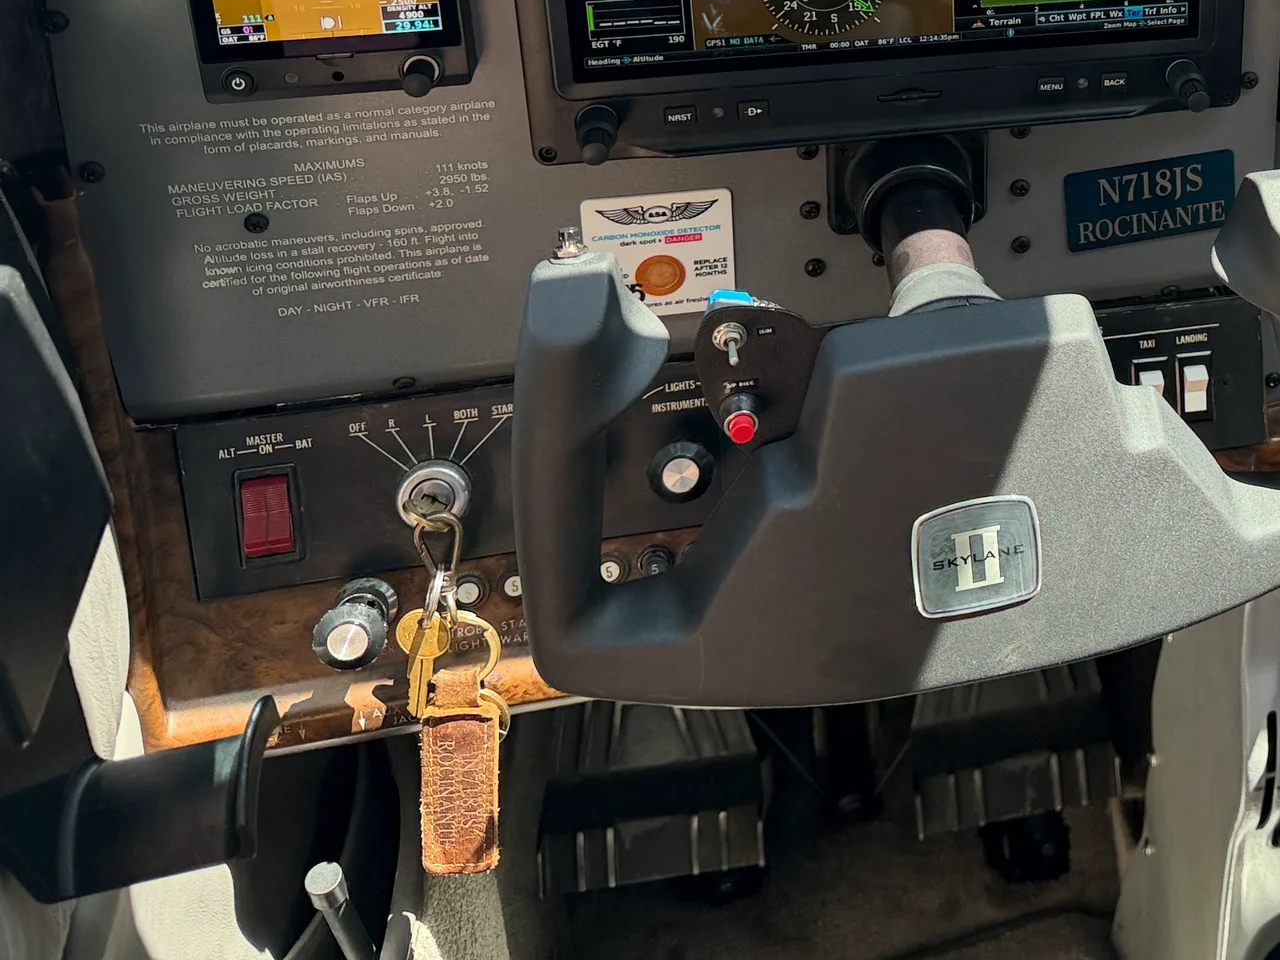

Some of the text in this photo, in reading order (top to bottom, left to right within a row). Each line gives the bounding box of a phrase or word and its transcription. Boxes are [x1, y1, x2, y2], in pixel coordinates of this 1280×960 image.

[989, 16, 1021, 26] Terrain
[588, 54, 664, 66] Heading Altitude
[1041, 78, 1126, 91] MENU BACK
[139, 100, 497, 135] This airplane must be operated as a normal category airplane
[668, 112, 692, 121] NRST
[294, 158, 366, 172] MAXIMUMS
[168, 160, 489, 195] MANEUVERING SPEED (IAS) 111 knots
[1097, 163, 1204, 206] N718JS
[172, 194, 220, 207] GROSS
[222, 189, 277, 203] WEIGHT
[440, 173, 468, 185] 2950
[1078, 200, 1225, 244] ROCINANTE
[591, 224, 721, 242] CARBON MONOXIDE DETECTOR
[620, 234, 701, 247] dark spot DANGER
[693, 257, 728, 266] REPLACE
[694, 264, 718, 272] AFTER
[695, 269, 728, 278] MONTHS
[1139, 333, 1208, 349] TAXI LANDING
[665, 380, 695, 393] LIGHTS
[348, 408, 478, 434] OFF R L BOTH
[246, 432, 284, 445] MASTER
[218, 438, 313, 459] ALT ON BAT
[933, 543, 1024, 571] SKYLANE
[436, 740, 456, 848] ROCINANTE
